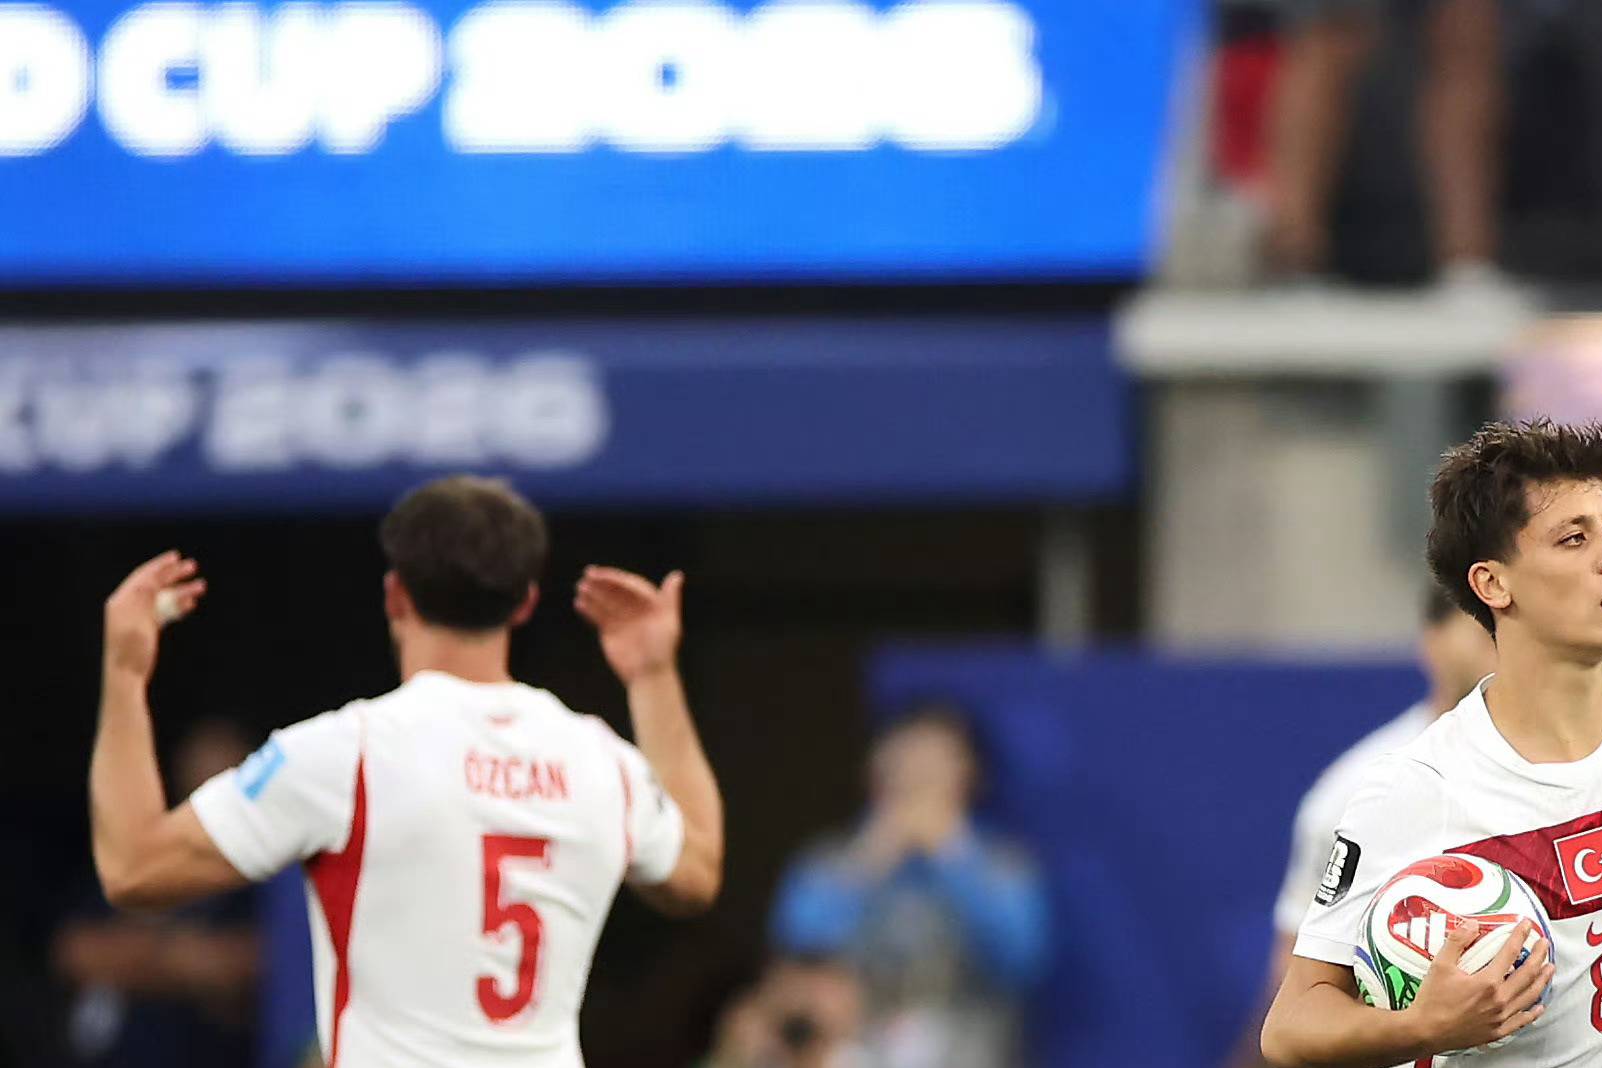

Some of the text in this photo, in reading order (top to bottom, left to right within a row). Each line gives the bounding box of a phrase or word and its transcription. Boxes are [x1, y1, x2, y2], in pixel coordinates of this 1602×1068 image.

[97, 2, 443, 157] CUP
[441, 0, 1043, 156] 2026
[205, 350, 608, 473] 2026
[464, 749, 570, 799] ÖZCAN
[475, 834, 553, 1025] 5
